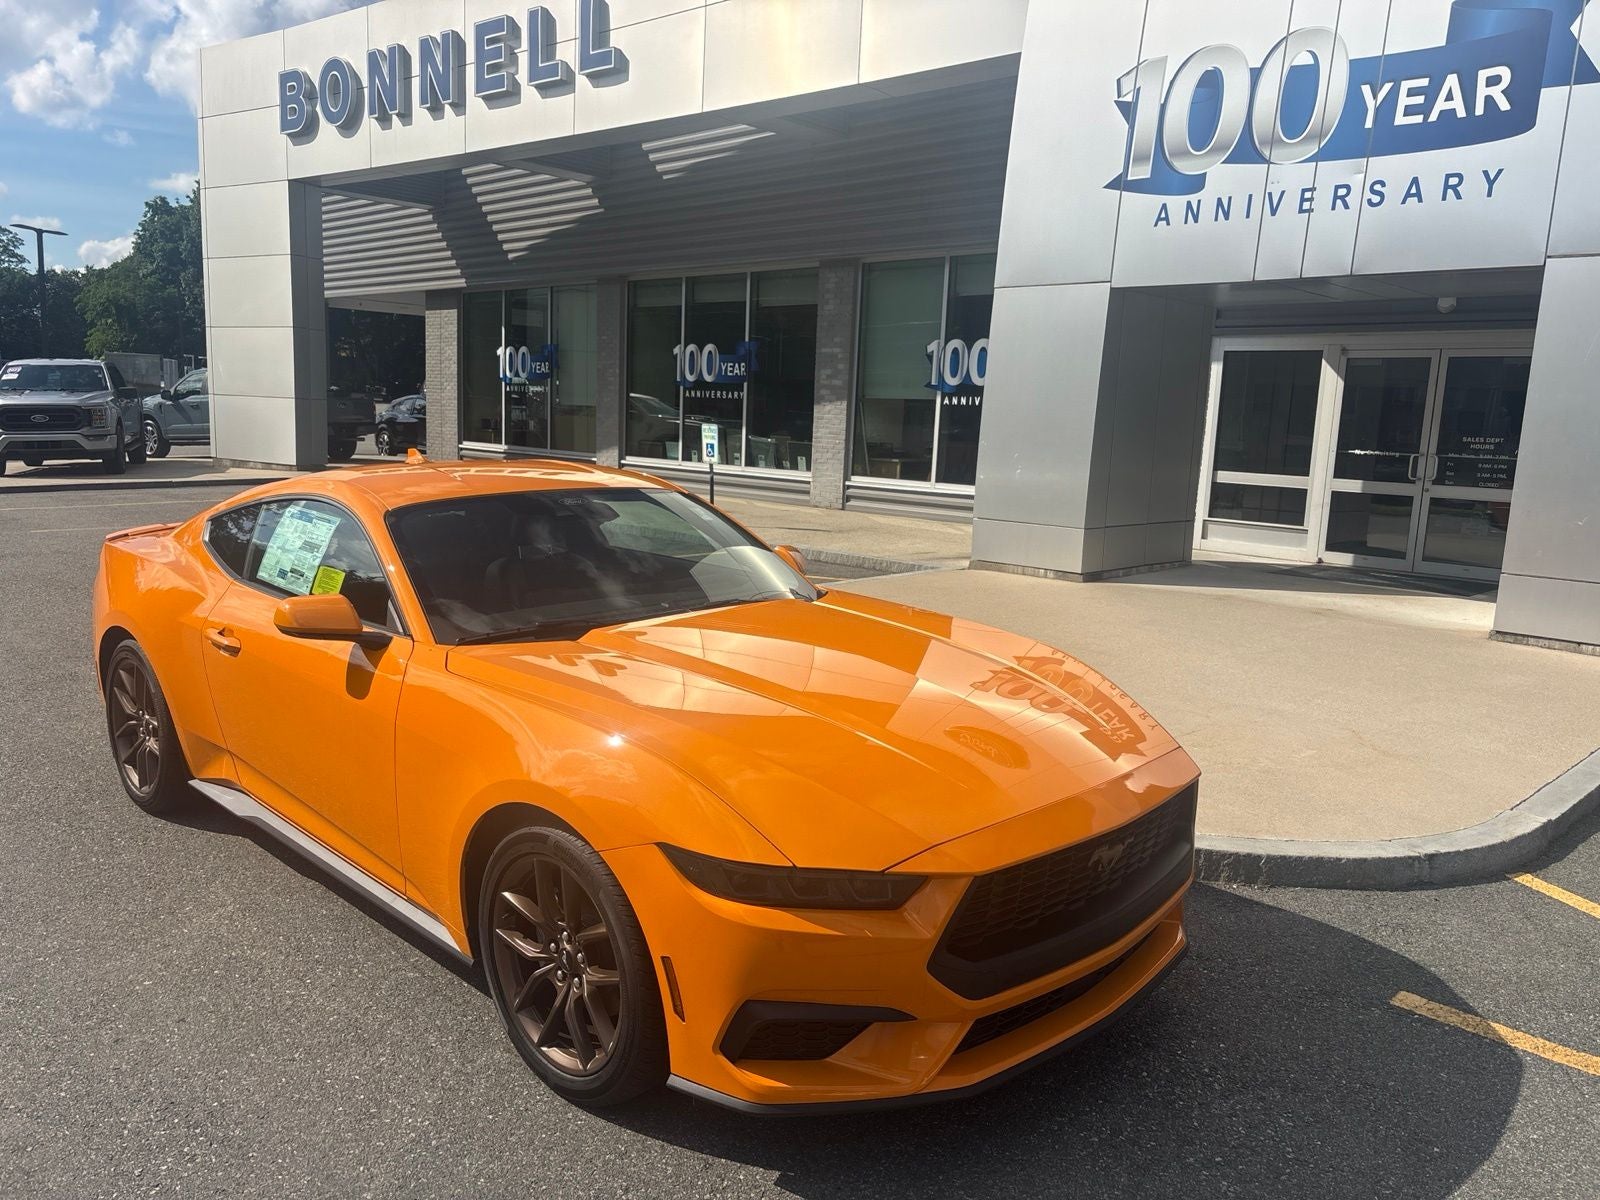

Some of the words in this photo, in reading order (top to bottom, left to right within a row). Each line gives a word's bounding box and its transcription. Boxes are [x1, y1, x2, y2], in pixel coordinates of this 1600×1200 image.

[278, 0, 625, 137] BONNELL
[1117, 26, 1349, 181] 100
[1359, 65, 1513, 129] YEAR
[1153, 168, 1505, 228] ANNIVERSARY
[497, 346, 531, 379] 100
[531, 362, 550, 373] YEAR
[673, 343, 720, 382] 100
[720, 362, 747, 376] YEAR
[926, 338, 989, 386] 100
[685, 390, 744, 399] ANNIVERSARY
